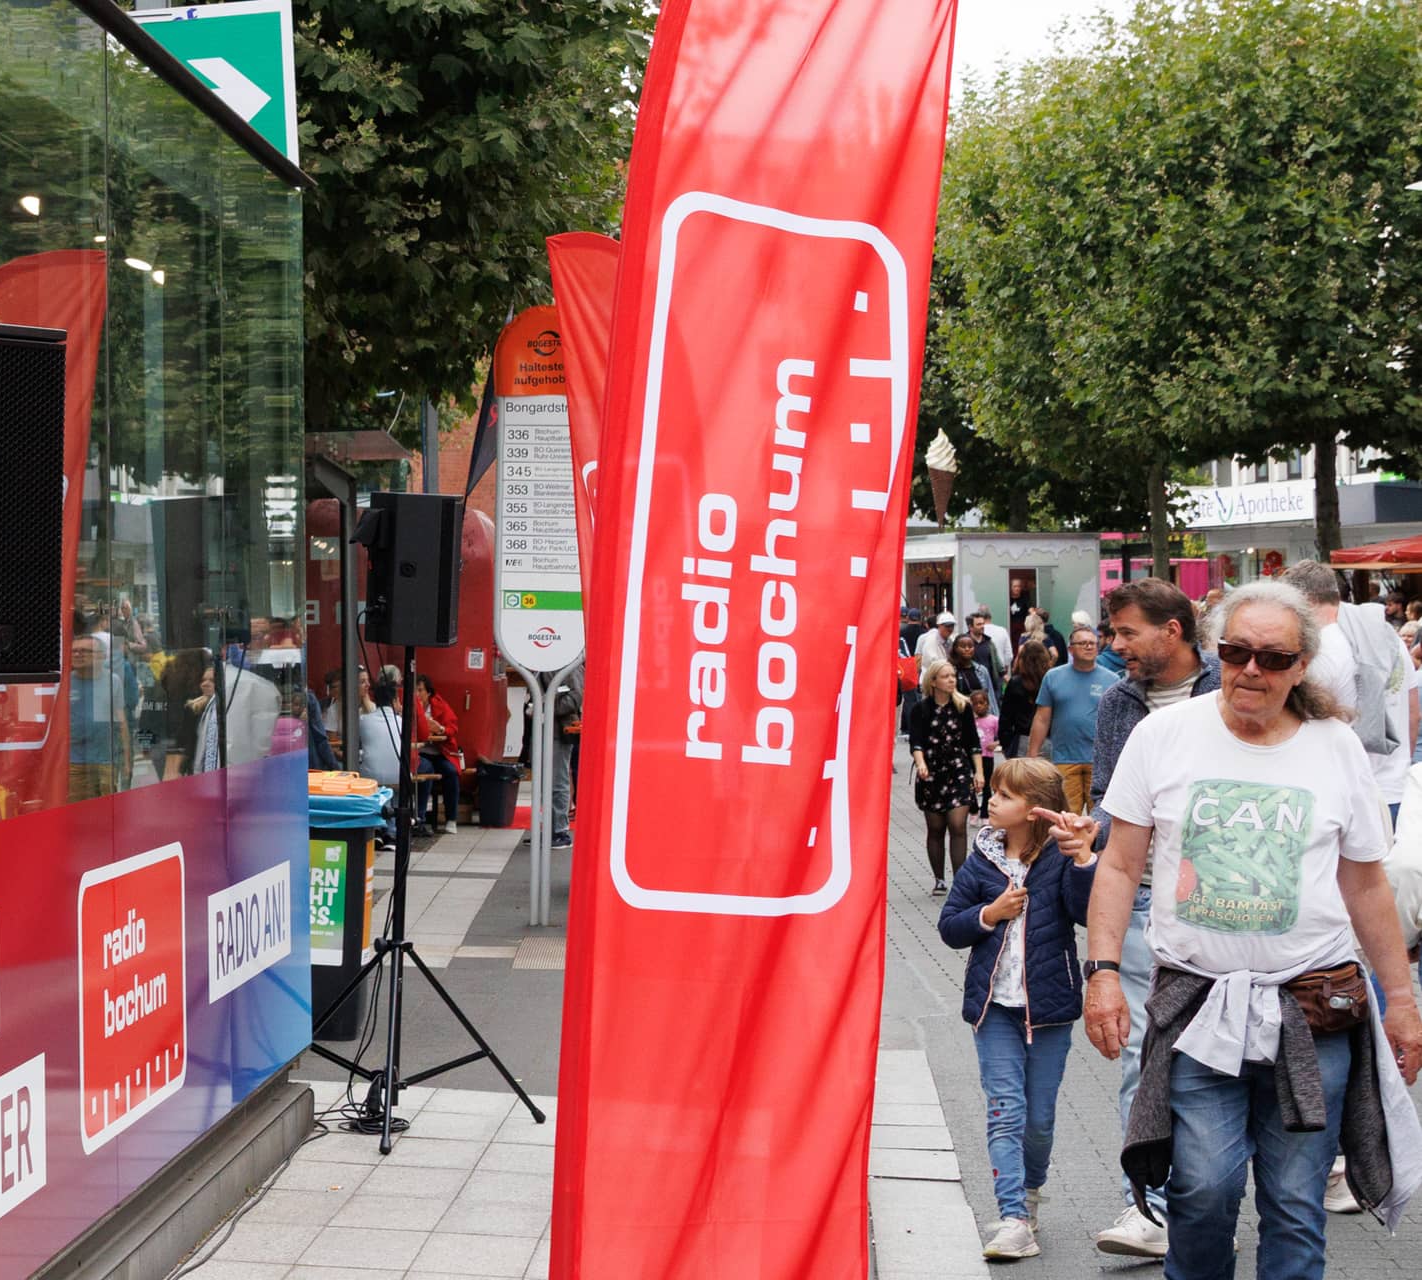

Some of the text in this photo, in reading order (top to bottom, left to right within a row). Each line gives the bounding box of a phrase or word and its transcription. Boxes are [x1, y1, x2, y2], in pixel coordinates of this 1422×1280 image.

[527, 339, 562, 348] BOGESTR
[507, 429, 530, 440] 336
[506, 447, 529, 458] 339
[506, 465, 532, 477] 345
[506, 484, 528, 495] 353
[505, 502, 528, 513] 355
[1236, 487, 1303, 521] Apotheke
[505, 521, 528, 532] 365
[505, 539, 528, 550] 368
[741, 356, 816, 767] bochum
[681, 491, 738, 761] radio
[1192, 797, 1305, 833] CAN
[310, 867, 340, 888] RN
[216, 893, 262, 980] RADIO
[263, 880, 286, 953] AN!
[103, 909, 146, 970] radio
[103, 971, 168, 1039] bochum
